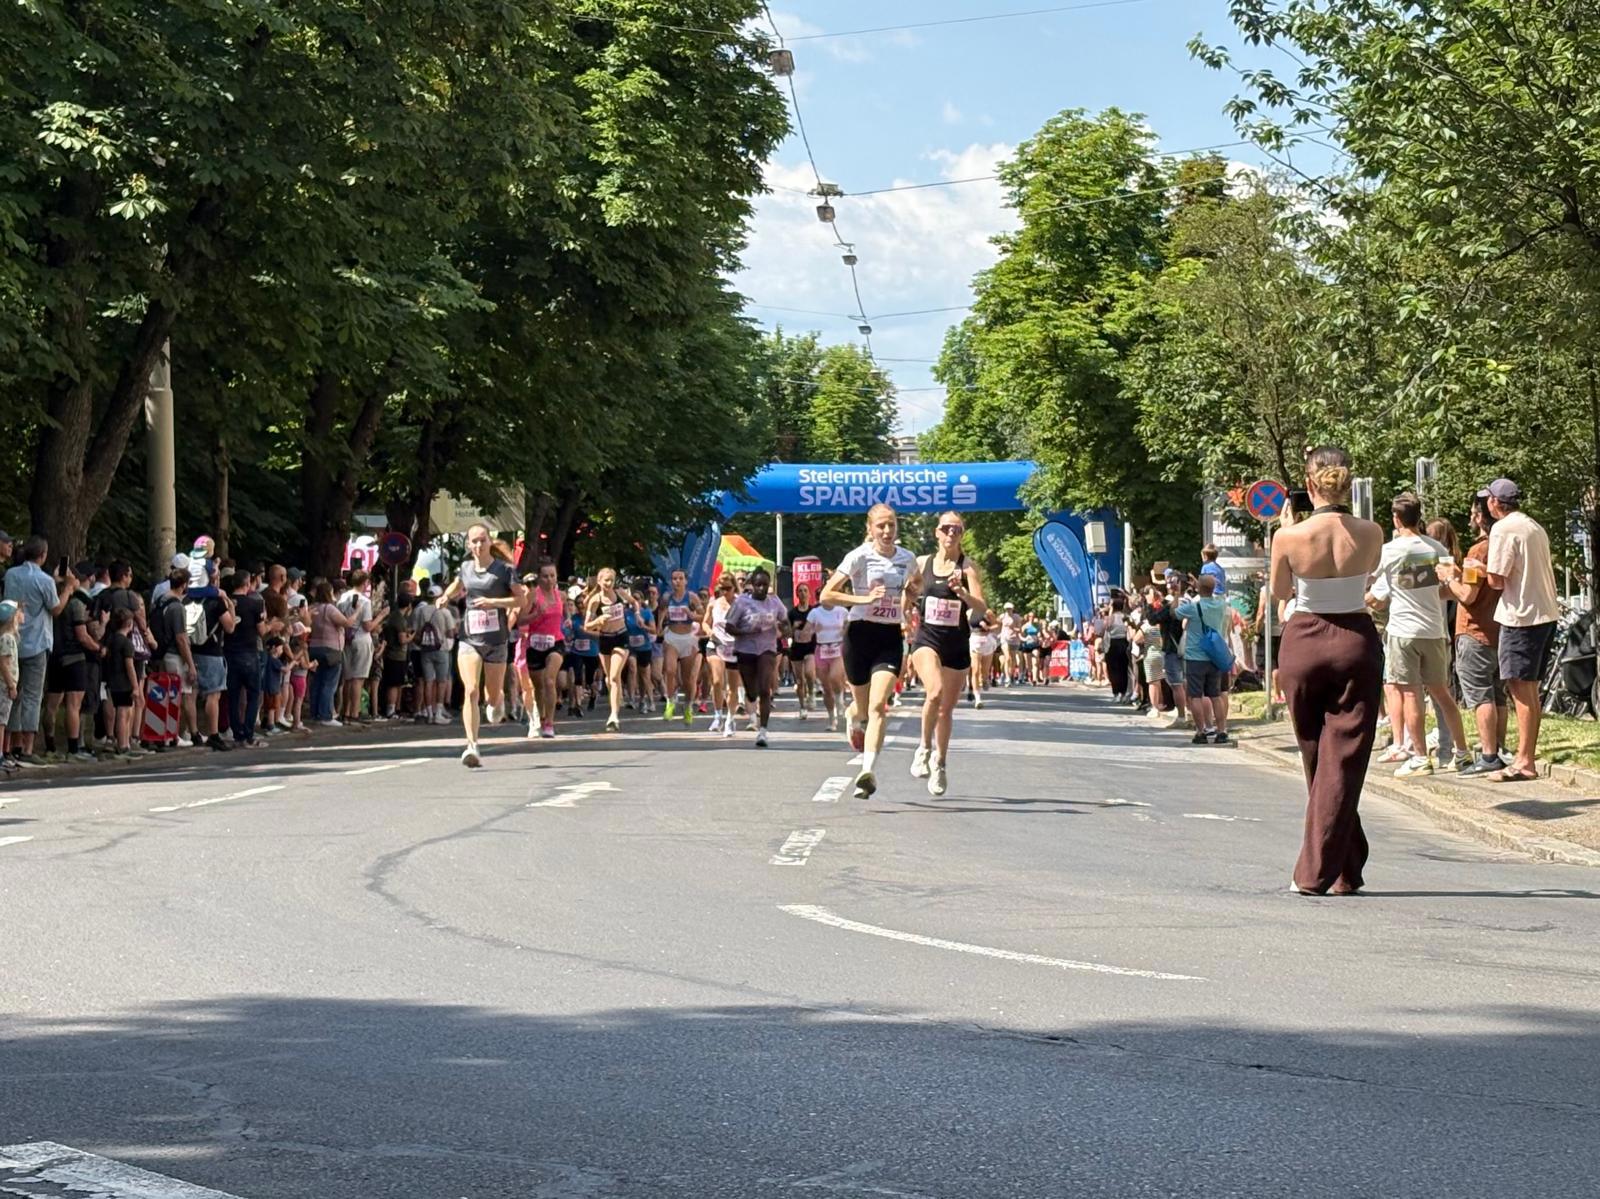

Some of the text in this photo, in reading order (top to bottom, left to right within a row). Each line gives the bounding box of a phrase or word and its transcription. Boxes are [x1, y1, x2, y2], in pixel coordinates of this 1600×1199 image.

[799, 468, 948, 485] Steiermärkische
[799, 485, 948, 507] SPARKASSE
[872, 606, 897, 618] 2270
